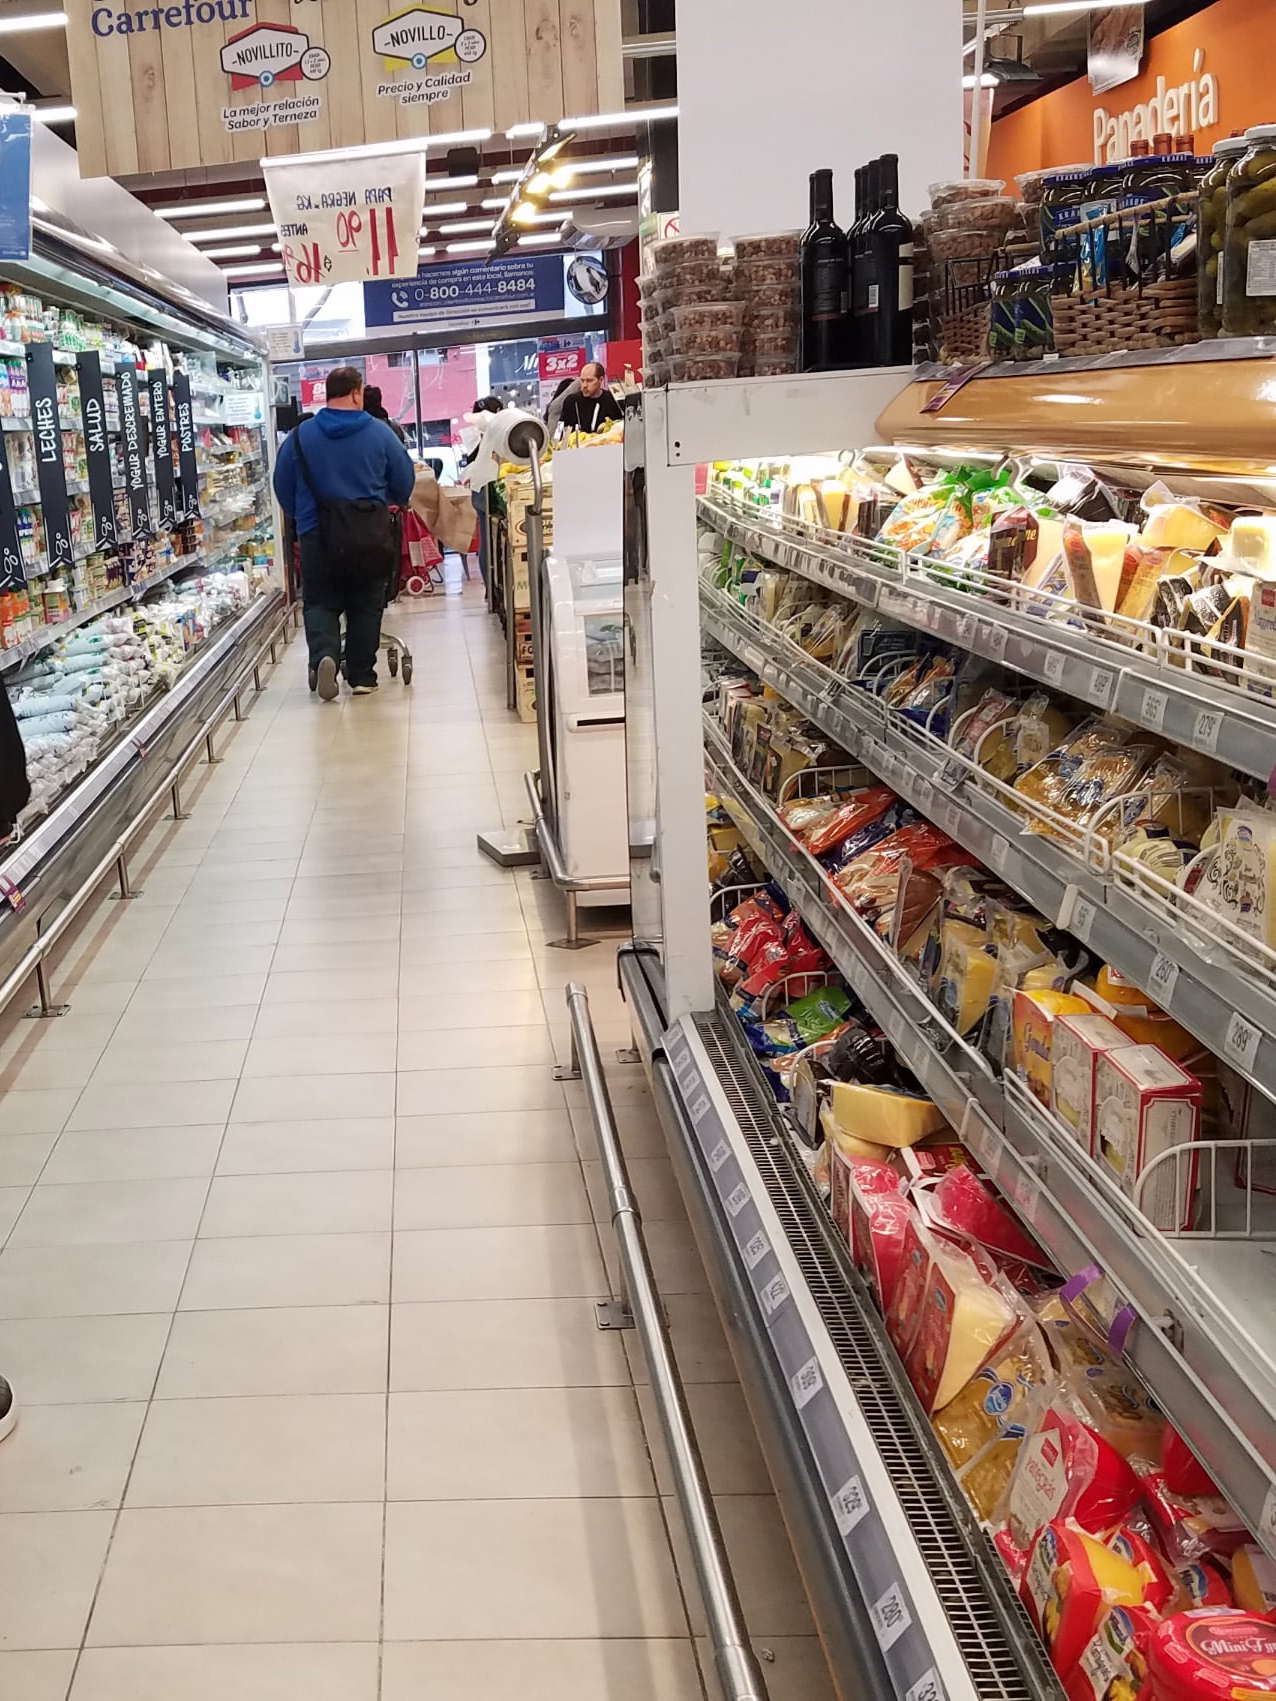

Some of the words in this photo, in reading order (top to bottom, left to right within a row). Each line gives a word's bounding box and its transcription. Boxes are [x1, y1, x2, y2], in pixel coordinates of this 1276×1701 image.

[92, 0, 252, 37] Carrefour
[378, 81, 414, 95] Precio
[416, 81, 423, 92] y
[425, 71, 472, 89] Calidad
[402, 89, 449, 104] siempre
[223, 108, 237, 119] La
[239, 103, 271, 118] mejor
[273, 96, 319, 111] relación
[227, 117, 260, 130] Sabor
[262, 118, 270, 128] y
[272, 109, 318, 124] Terneza
[1092, 48, 1220, 166] Panadería
[391, 280, 428, 290] experiencia
[438, 276, 463, 285] compra
[452, 268, 470, 277] algún
[470, 264, 506, 275] comentario
[507, 262, 525, 270] sobre
[414, 277, 536, 301] 0-800-444-8484
[545, 353, 579, 373] 3x2
[121, 371, 139, 452] DESCREMADO
[155, 380, 168, 428] ENTERO
[35, 396, 57, 463] LECHES
[85, 397, 105, 453] SALUD
[175, 401, 193, 453] POSTRES
[156, 427, 170, 460] YOGUR
[126, 453, 145, 491] YOGUR
[1233, 1030, 1249, 1053] 289
[880, 1593, 903, 1629] 280
